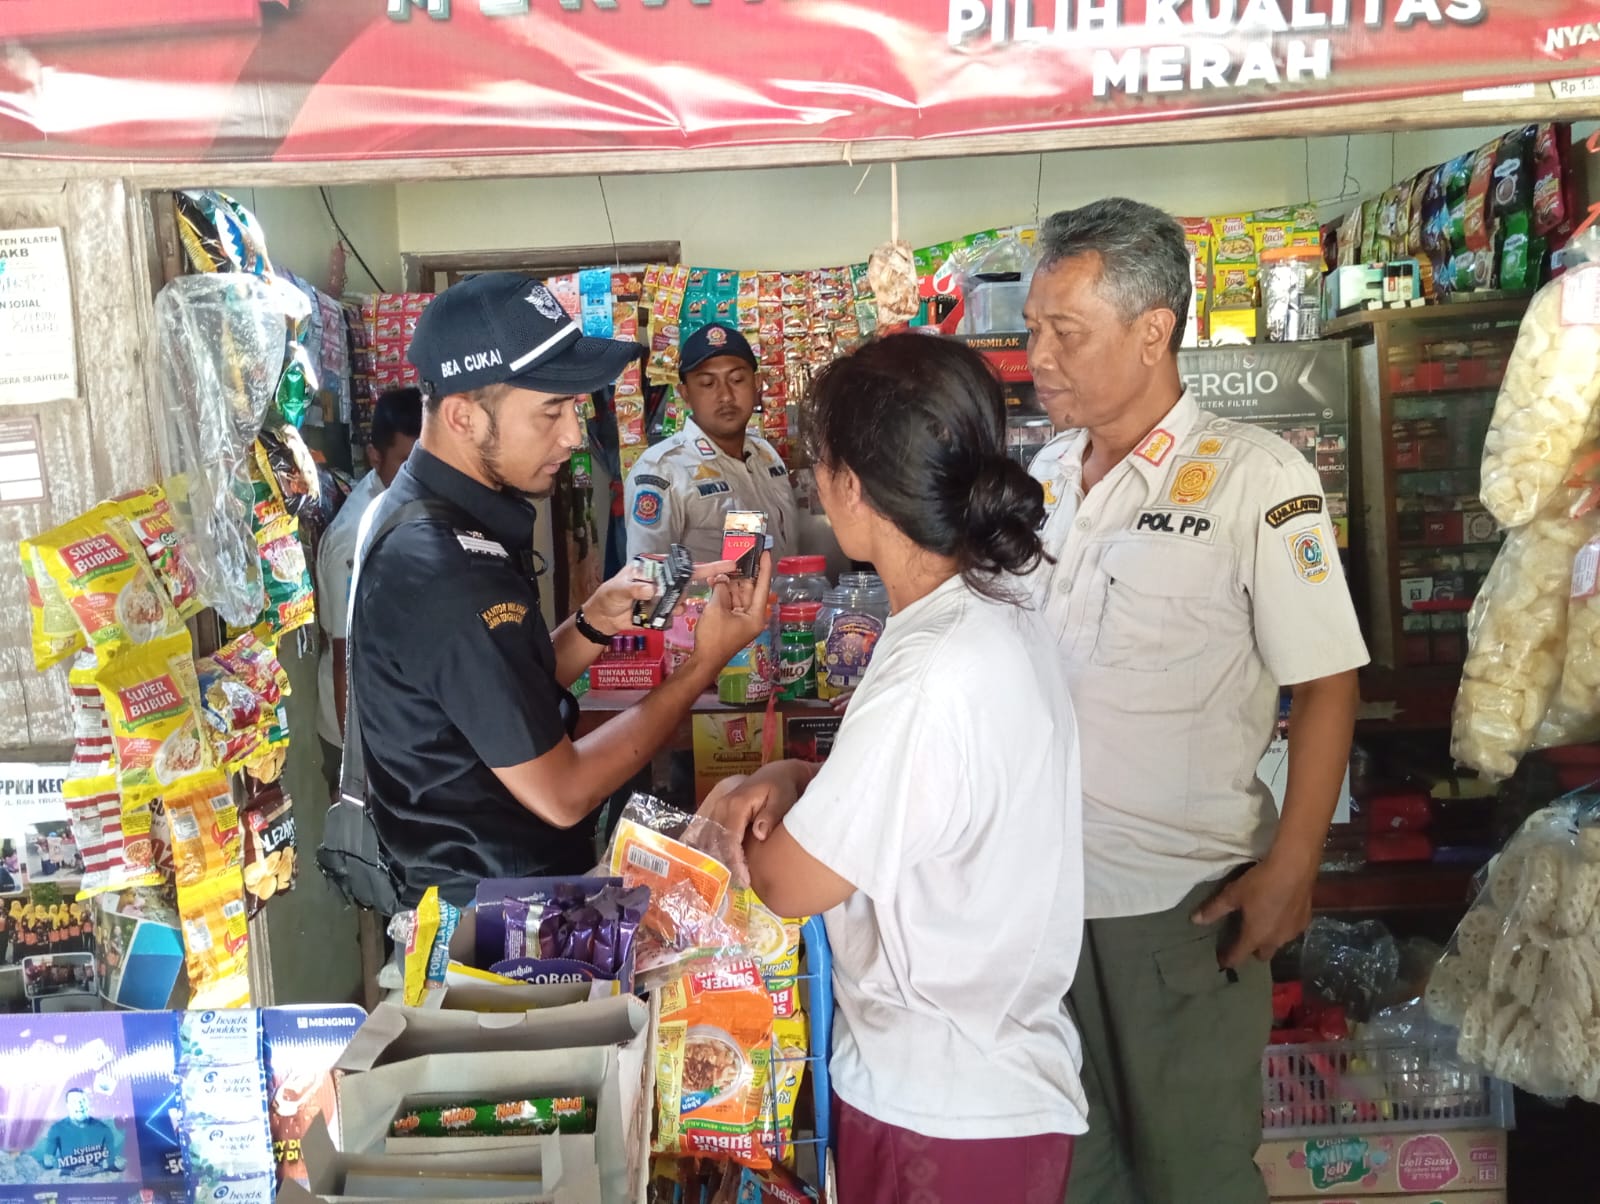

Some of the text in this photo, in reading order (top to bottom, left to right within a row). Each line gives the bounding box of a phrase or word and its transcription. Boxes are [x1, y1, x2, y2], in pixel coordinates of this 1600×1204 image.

[1092, 39, 1332, 95] MERAH
[19, 235, 58, 245] KLATEN
[9, 299, 41, 309] SOSIAL
[967, 337, 1019, 348] WISMILAK
[440, 348, 503, 378] BEA CUKAI
[1227, 399, 1258, 407] FILTER
[1136, 512, 1211, 537] POL PP
[69, 537, 111, 560] SUPER
[74, 547, 123, 573] BUBUR
[627, 668, 652, 676] WANGI
[125, 681, 168, 704] SUPER
[129, 692, 177, 718] BUBUR
[309, 1017, 356, 1026] MENGNIU
[73, 1143, 105, 1155] Kylian
[1322, 1159, 1354, 1182] Jelly
